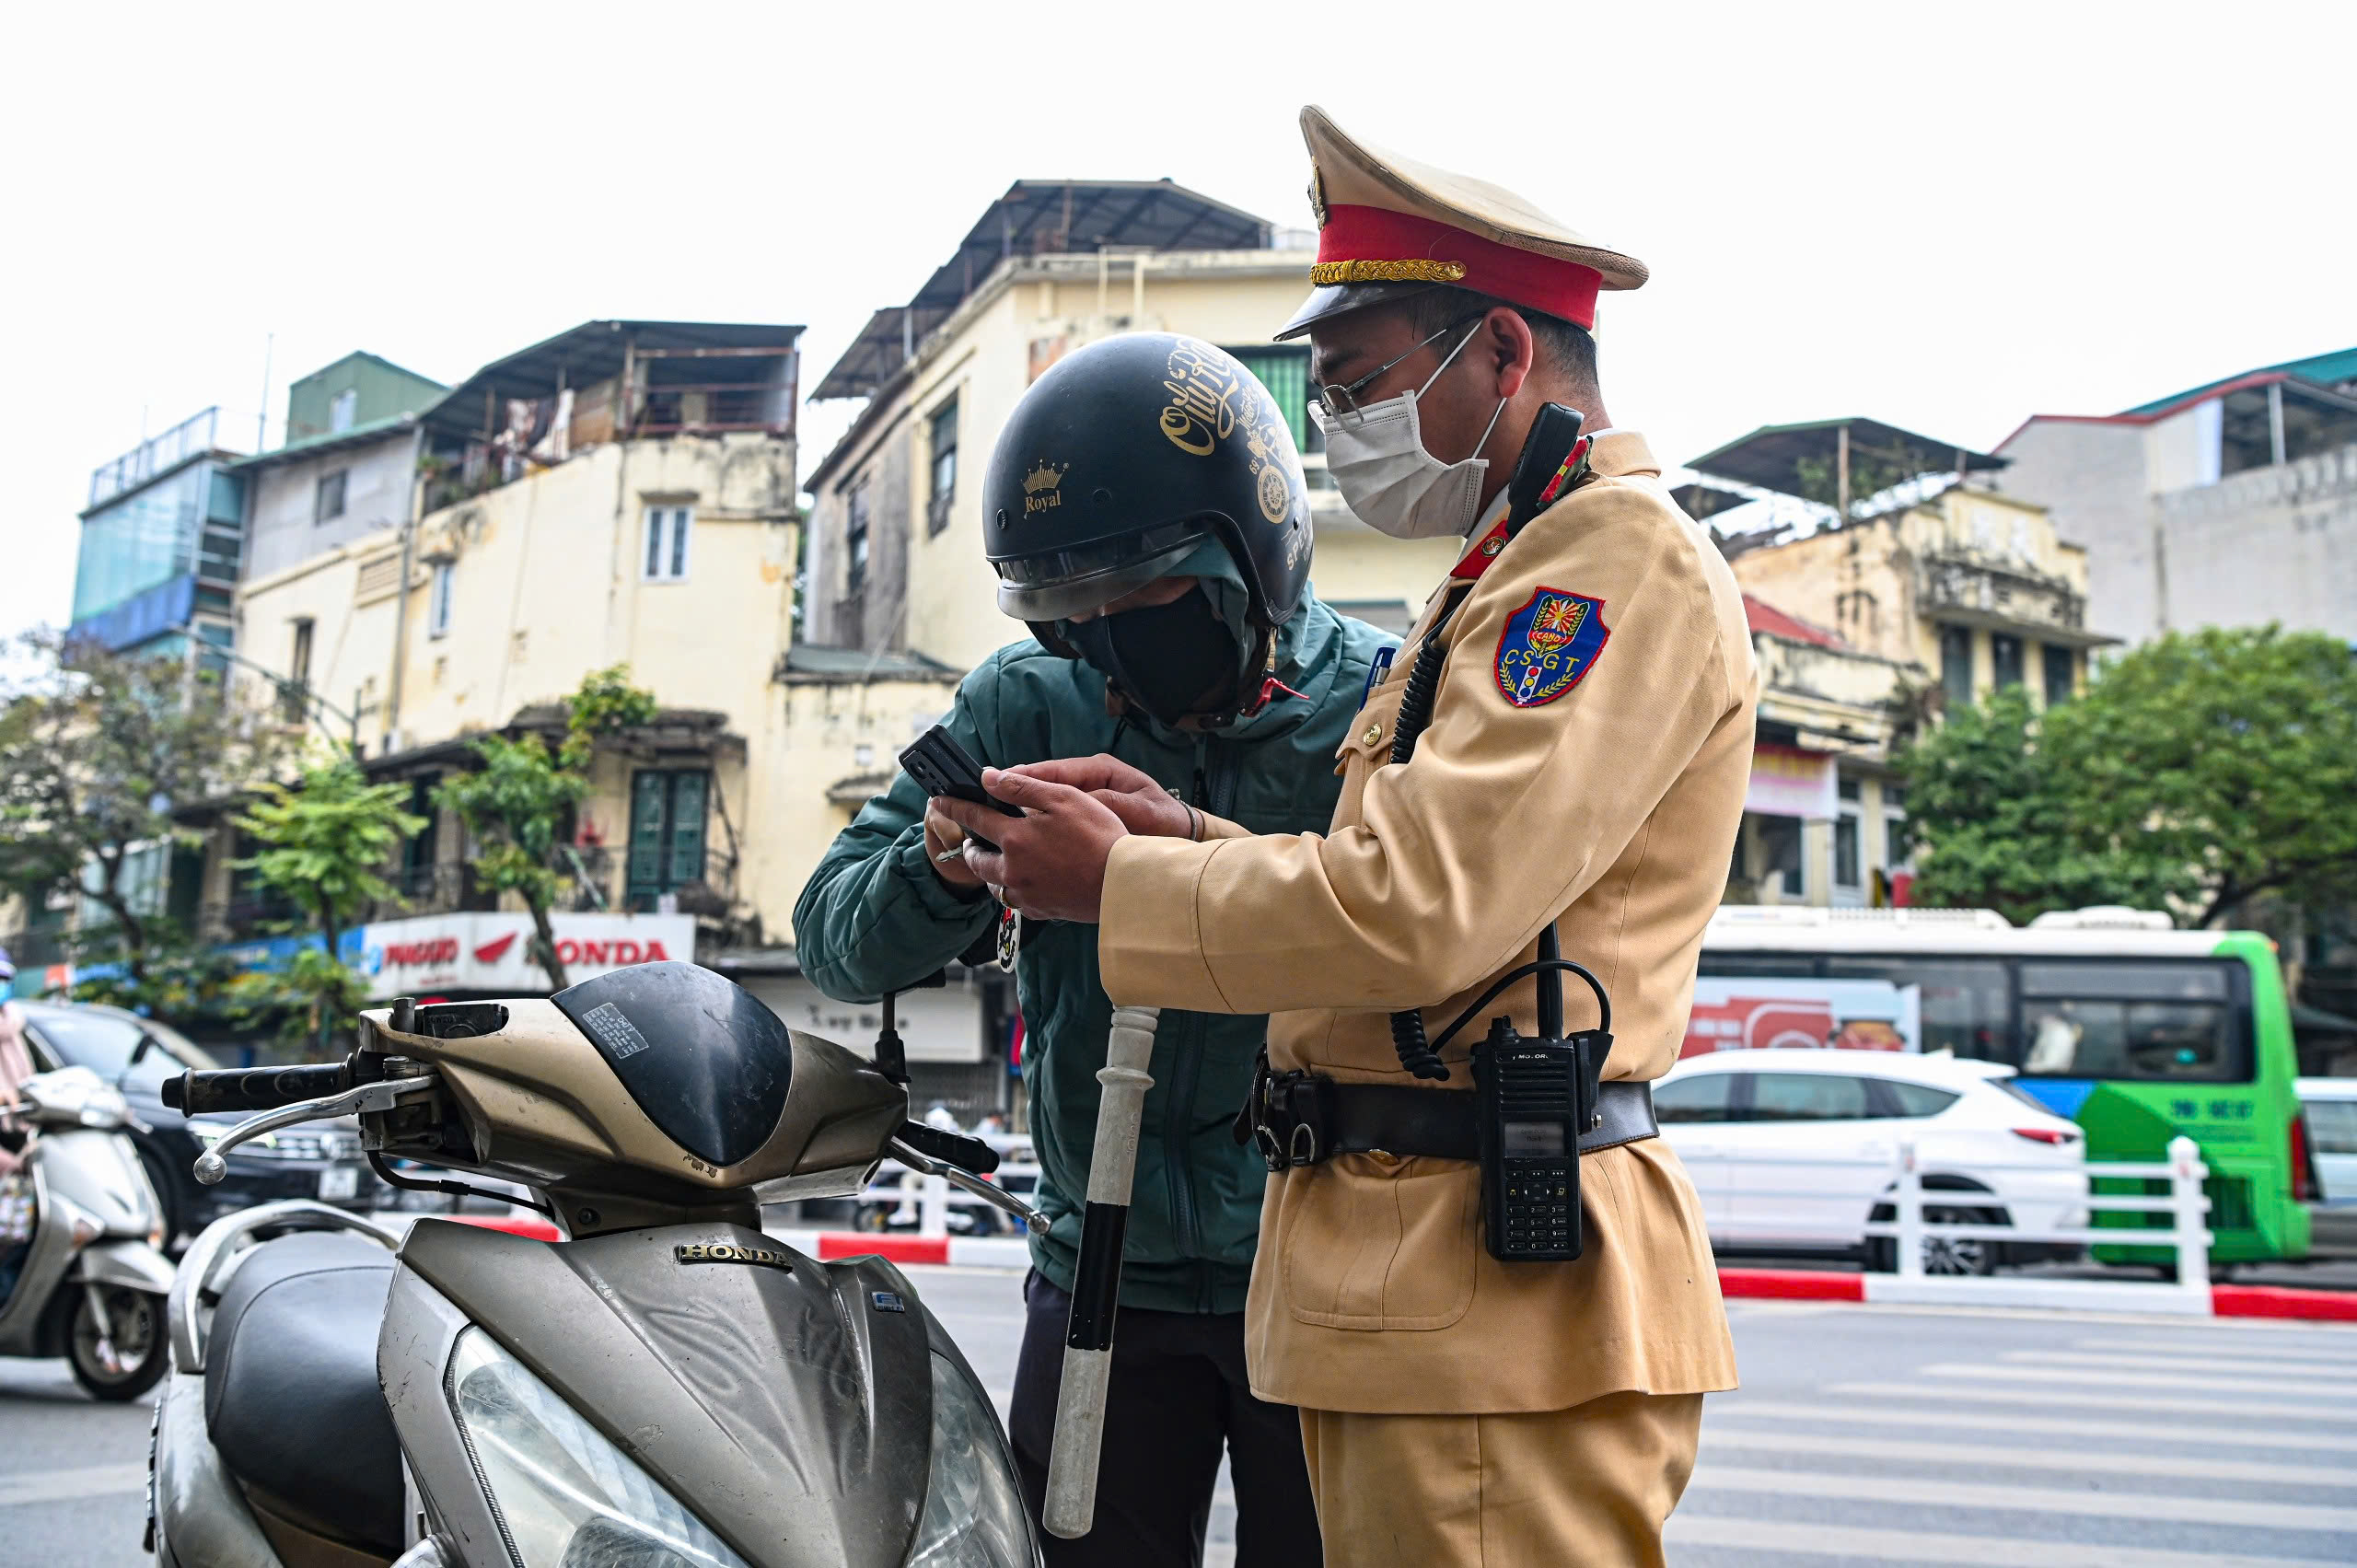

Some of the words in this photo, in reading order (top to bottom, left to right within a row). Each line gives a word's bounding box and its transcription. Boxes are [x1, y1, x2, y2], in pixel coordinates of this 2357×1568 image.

[1025, 490, 1062, 513] Royal
[1536, 632, 1562, 643] CAND
[527, 937, 669, 965] ONDA
[680, 1244, 793, 1267] HONDA
